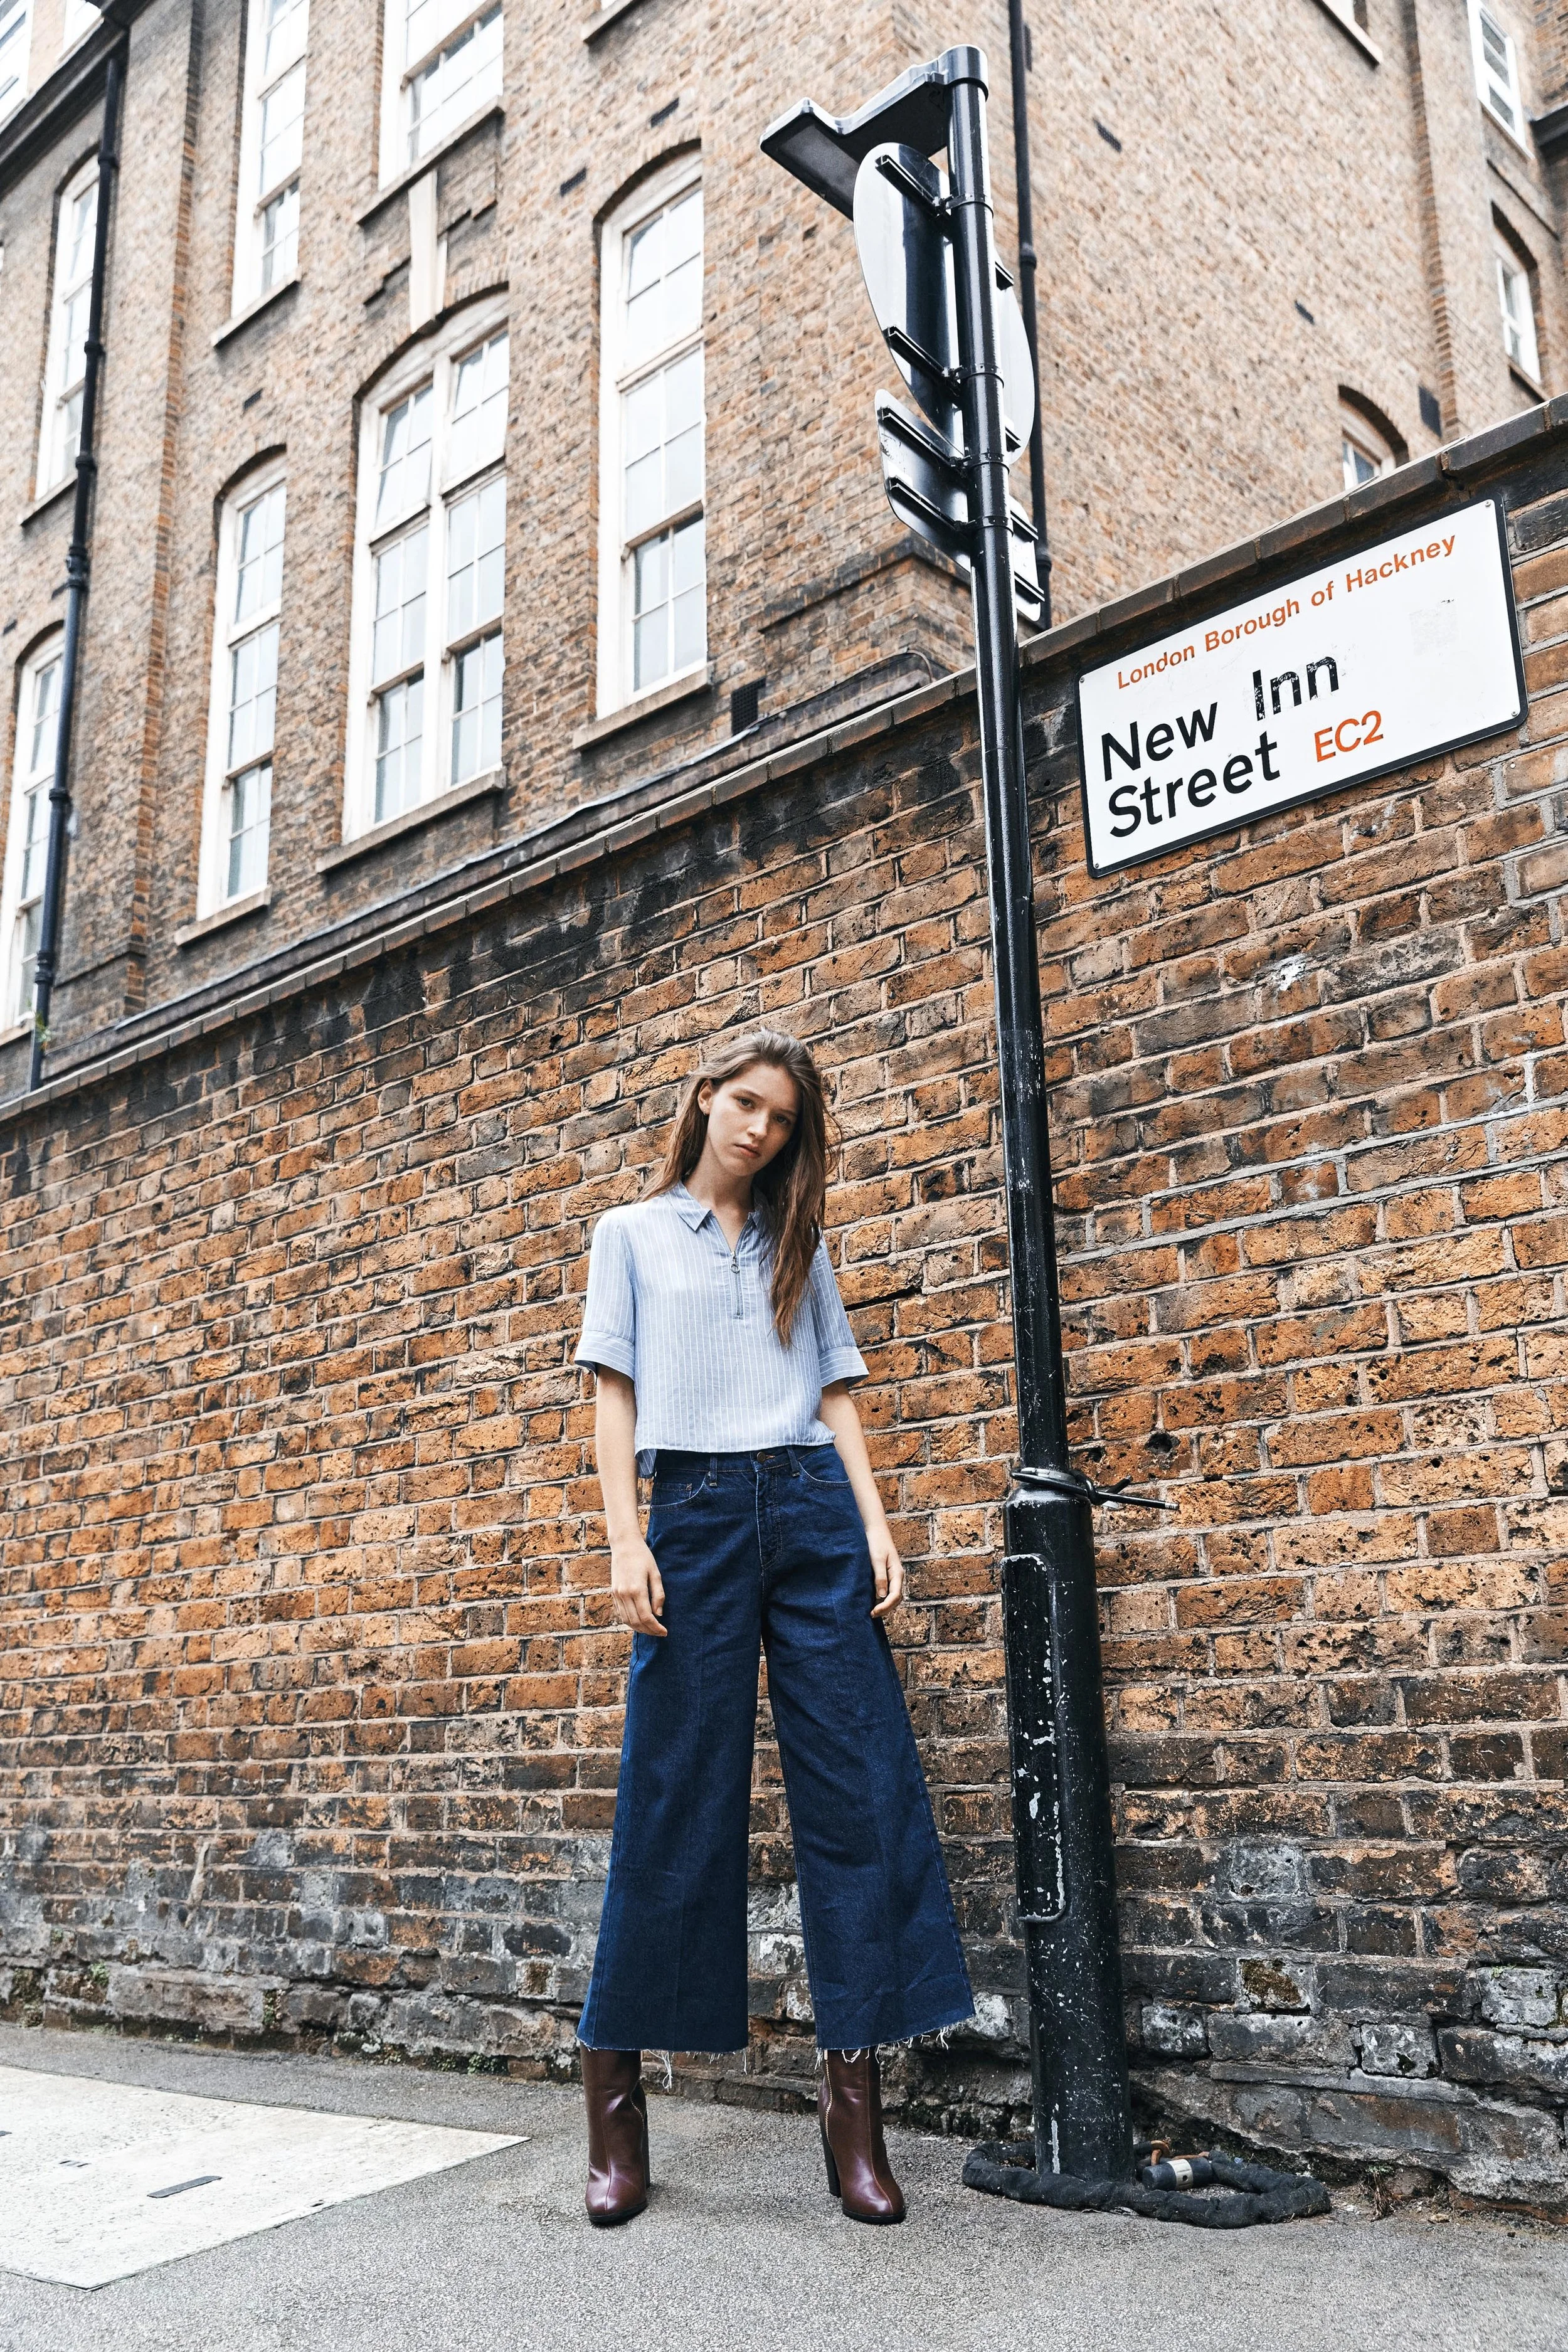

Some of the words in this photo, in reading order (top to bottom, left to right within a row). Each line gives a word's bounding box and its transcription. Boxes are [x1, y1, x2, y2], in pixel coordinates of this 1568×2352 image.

[1117, 645, 1195, 689] London
[1204, 598, 1300, 652] Borough
[1311, 581, 1334, 607] of
[1345, 534, 1455, 592] Hackney
[1101, 701, 1219, 782] New
[1252, 655, 1340, 722] Inn
[1108, 731, 1281, 838] Street
[1314, 709, 1384, 763] EC2
